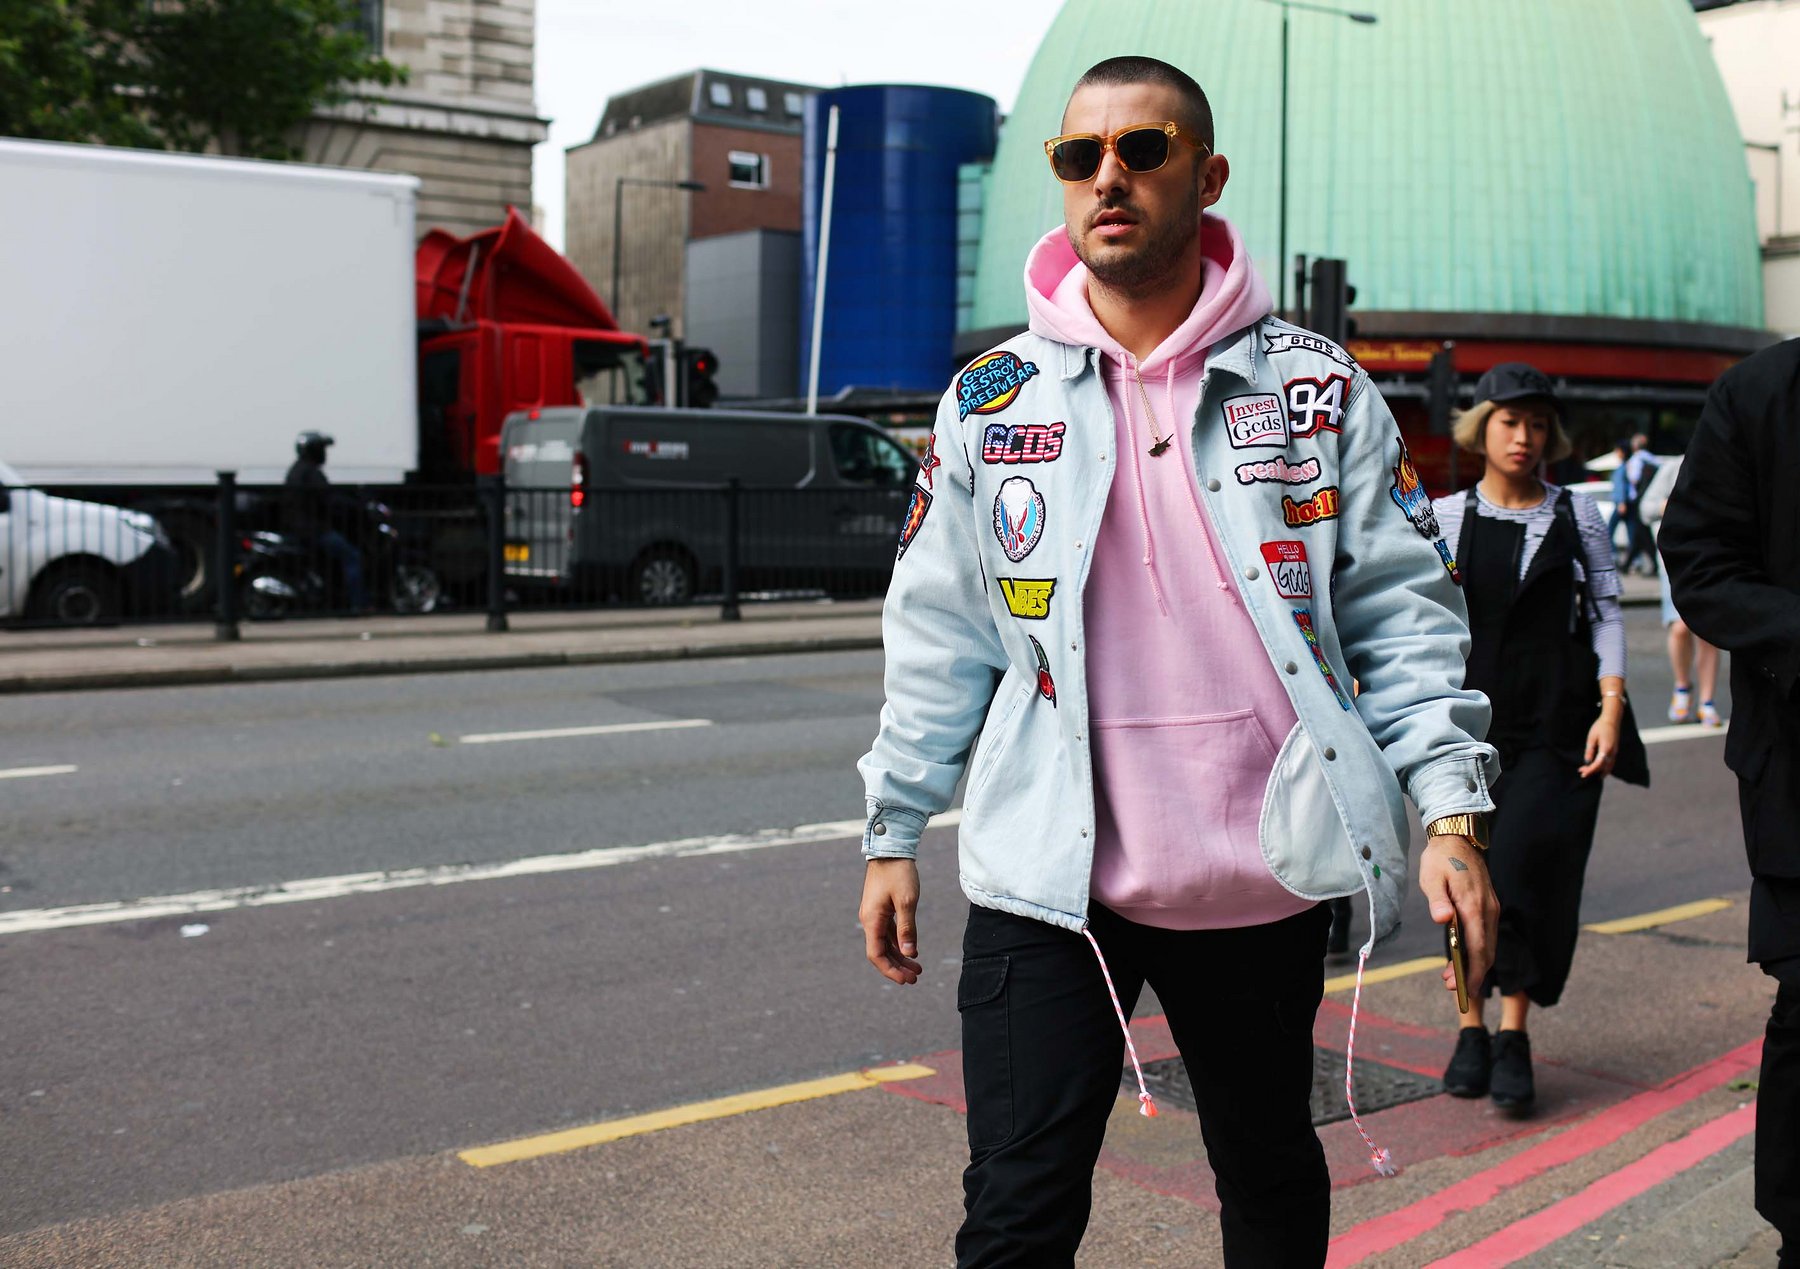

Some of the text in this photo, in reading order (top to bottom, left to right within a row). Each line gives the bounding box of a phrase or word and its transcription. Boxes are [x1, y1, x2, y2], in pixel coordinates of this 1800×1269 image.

[1290, 336, 1333, 355] GCDS
[960, 359, 1015, 400] DESTROY
[962, 367, 986, 385] GOD
[960, 363, 1037, 419] STREETWEAR
[1226, 397, 1277, 425] Invest
[1289, 379, 1344, 433] 94
[1233, 415, 1281, 441] Gcds
[983, 422, 1065, 463] GCDS
[1276, 543, 1300, 555] HELLO
